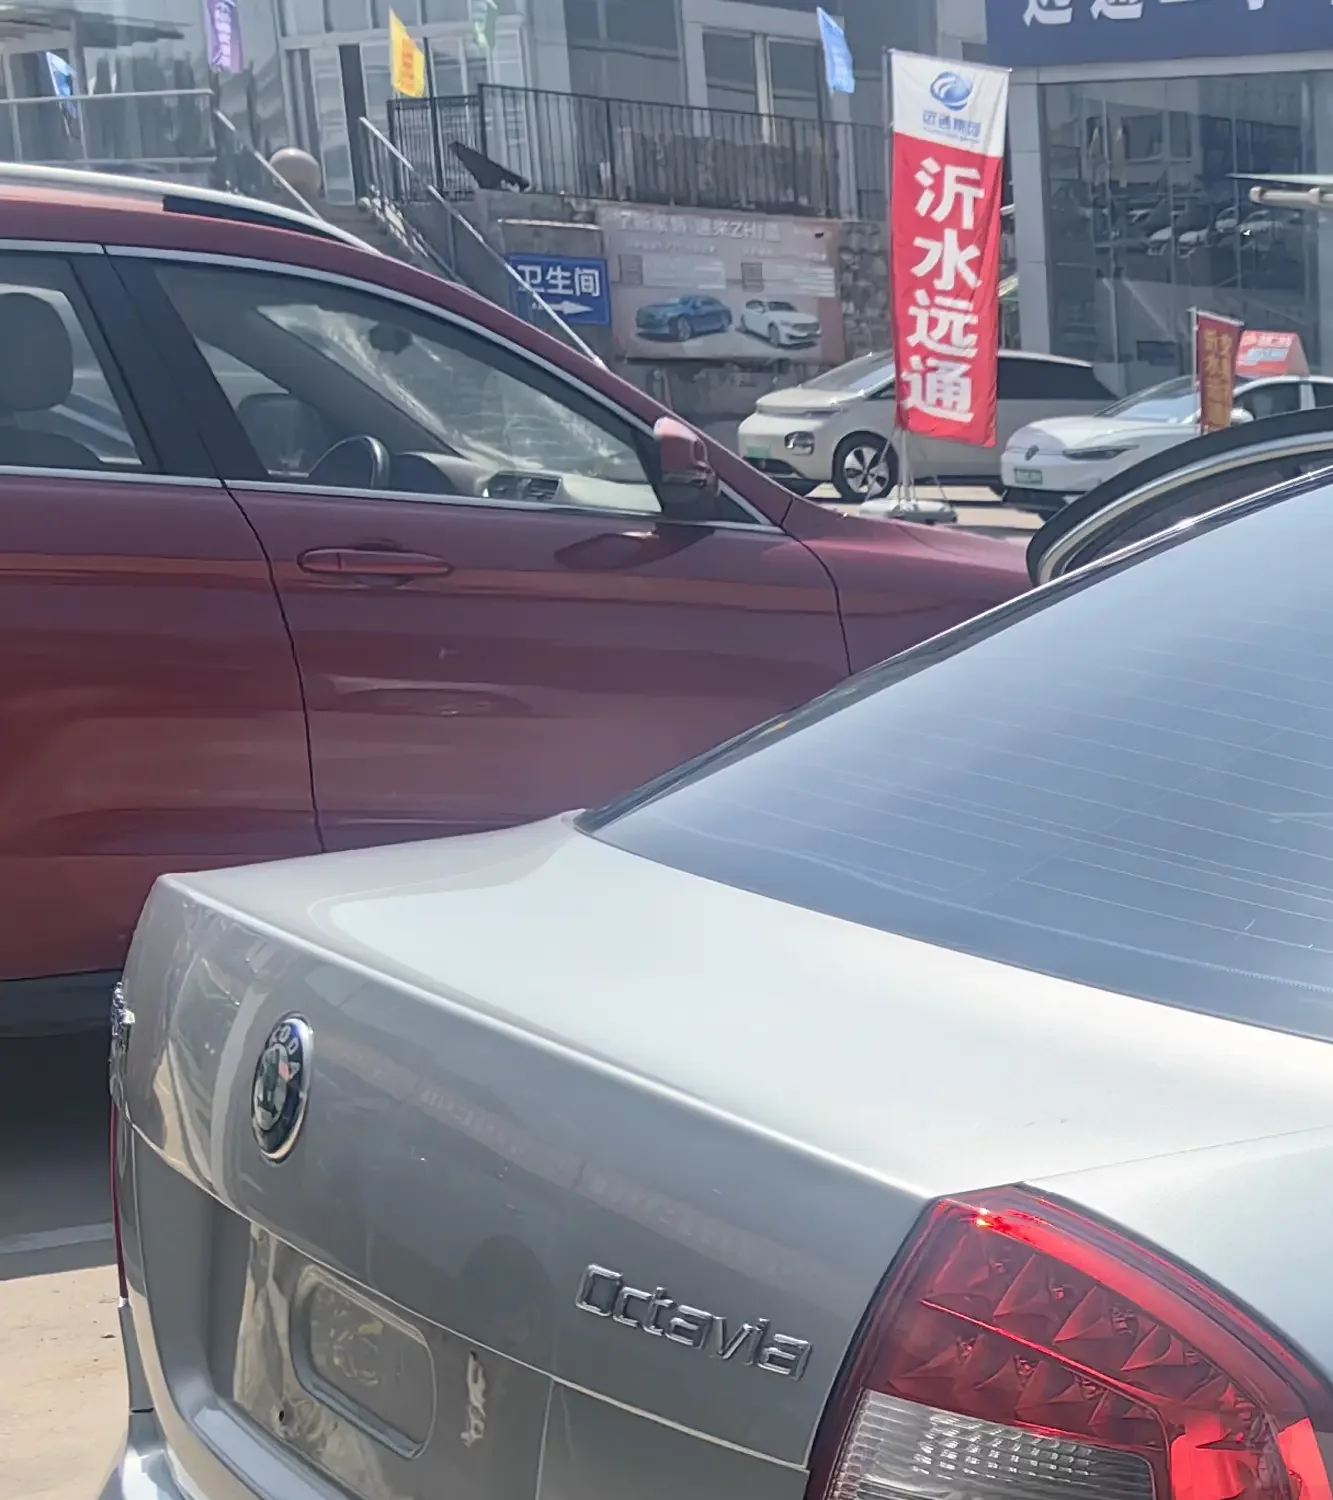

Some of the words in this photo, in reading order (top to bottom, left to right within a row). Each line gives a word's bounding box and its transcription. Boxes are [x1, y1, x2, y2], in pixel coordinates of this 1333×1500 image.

[516, 264, 601, 298] 卫生间
[901, 156, 985, 424] 沂水远通
[575, 1262, 813, 1382] Octavia
